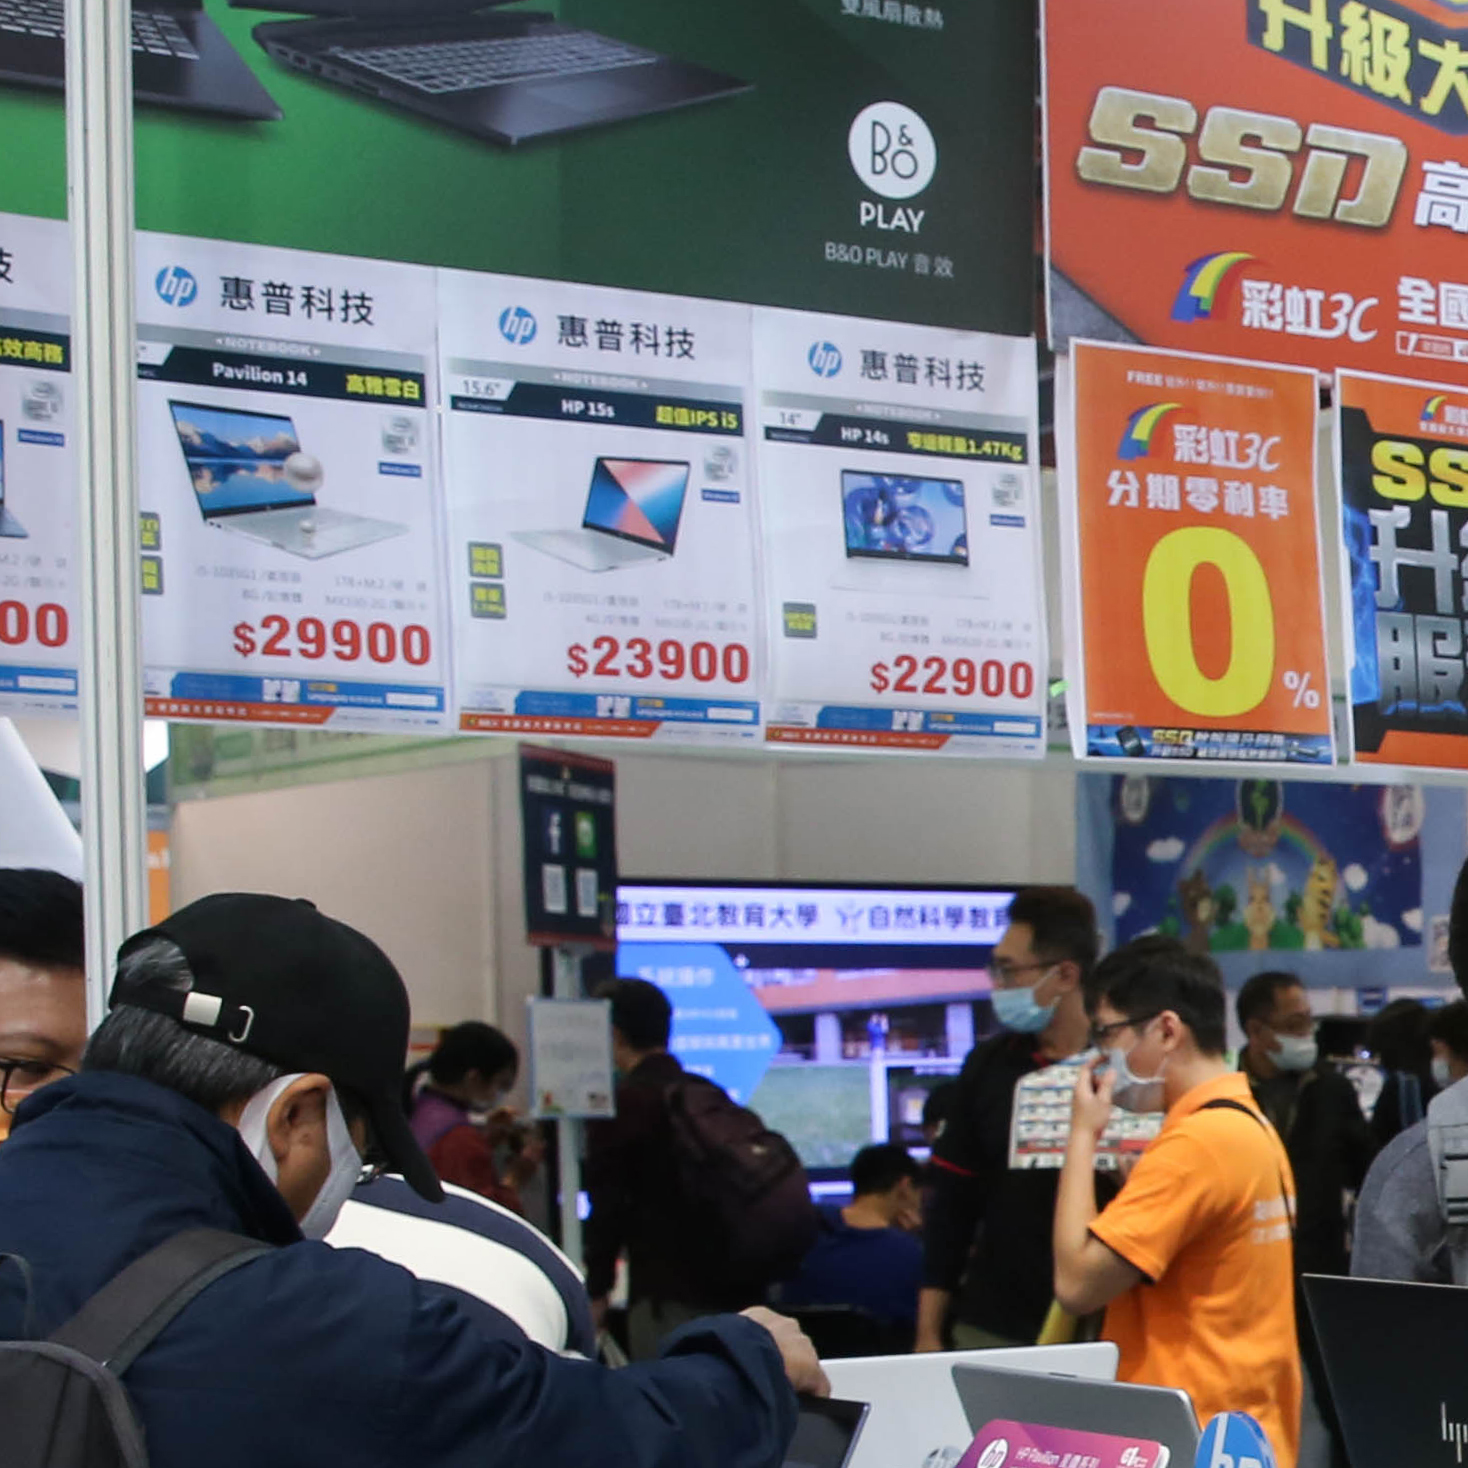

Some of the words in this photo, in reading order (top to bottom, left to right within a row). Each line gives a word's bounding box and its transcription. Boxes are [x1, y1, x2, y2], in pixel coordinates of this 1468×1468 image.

[1077, 84, 1408, 229] SSD
[860, 201, 924, 233] PLAY
[824, 242, 862, 264] B&O
[865, 248, 908, 269] PLAY
[156, 265, 198, 307] hp
[220, 276, 373, 326] 惠普科技
[1241, 279, 1379, 344] 彩虹3C
[499, 306, 537, 344] hp
[558, 315, 695, 359] 惠普科技
[213, 362, 283, 385] Pavilion
[287, 369, 307, 387] 14
[808, 342, 842, 377] hp
[860, 348, 985, 392] 惠普科技
[463, 378, 501, 397] 15.6"
[561, 399, 585, 415] HP
[588, 403, 614, 419] 15s
[841, 427, 861, 443] HP
[864, 429, 889, 445] 14s
[1174, 422, 1281, 473] 彩虹3C
[1107, 469, 1288, 519] 分期零利率
[233, 614, 430, 666] $29900
[567, 635, 749, 683] $23900
[870, 656, 1033, 698] $22900
